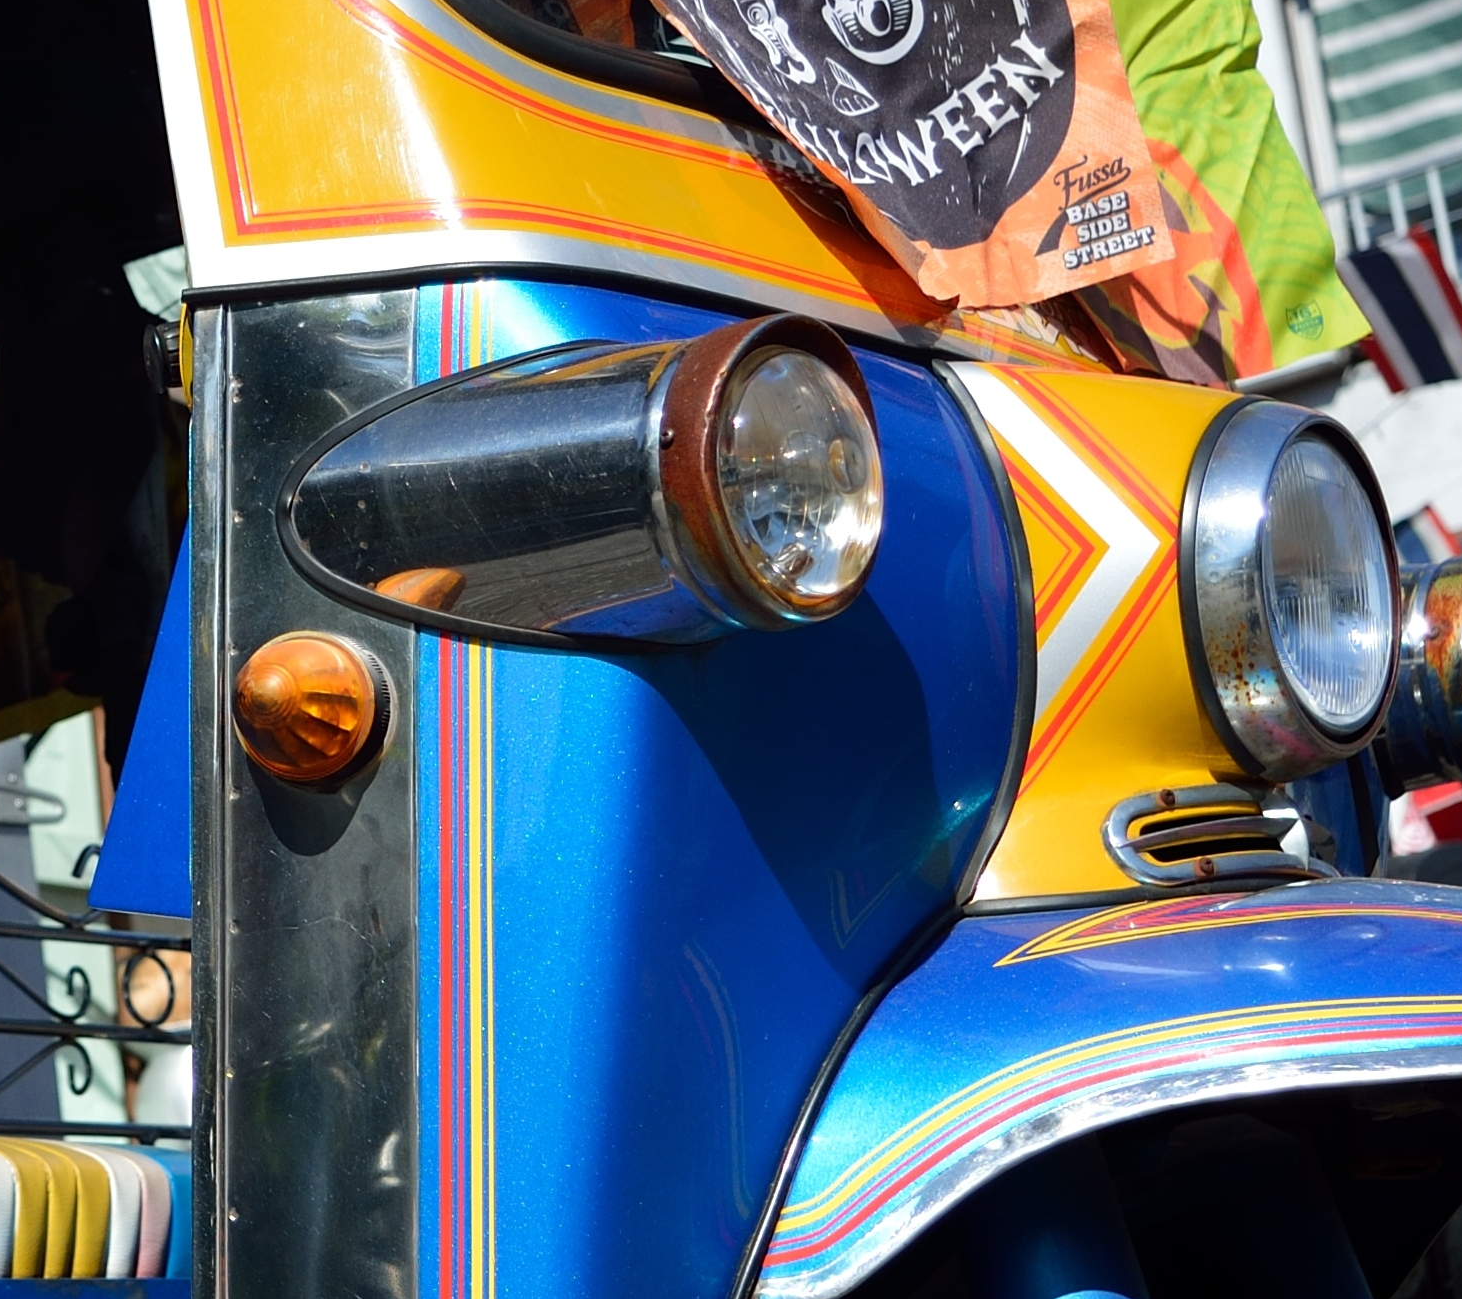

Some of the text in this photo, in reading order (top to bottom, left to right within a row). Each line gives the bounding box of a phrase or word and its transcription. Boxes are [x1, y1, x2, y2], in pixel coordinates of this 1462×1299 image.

[778, 28, 1065, 187] ALLOWEEN
[1053, 154, 1131, 212] Fussa
[1065, 189, 1130, 227] BASE
[1076, 212, 1132, 245] SIDE
[1062, 225, 1155, 270] STREET
